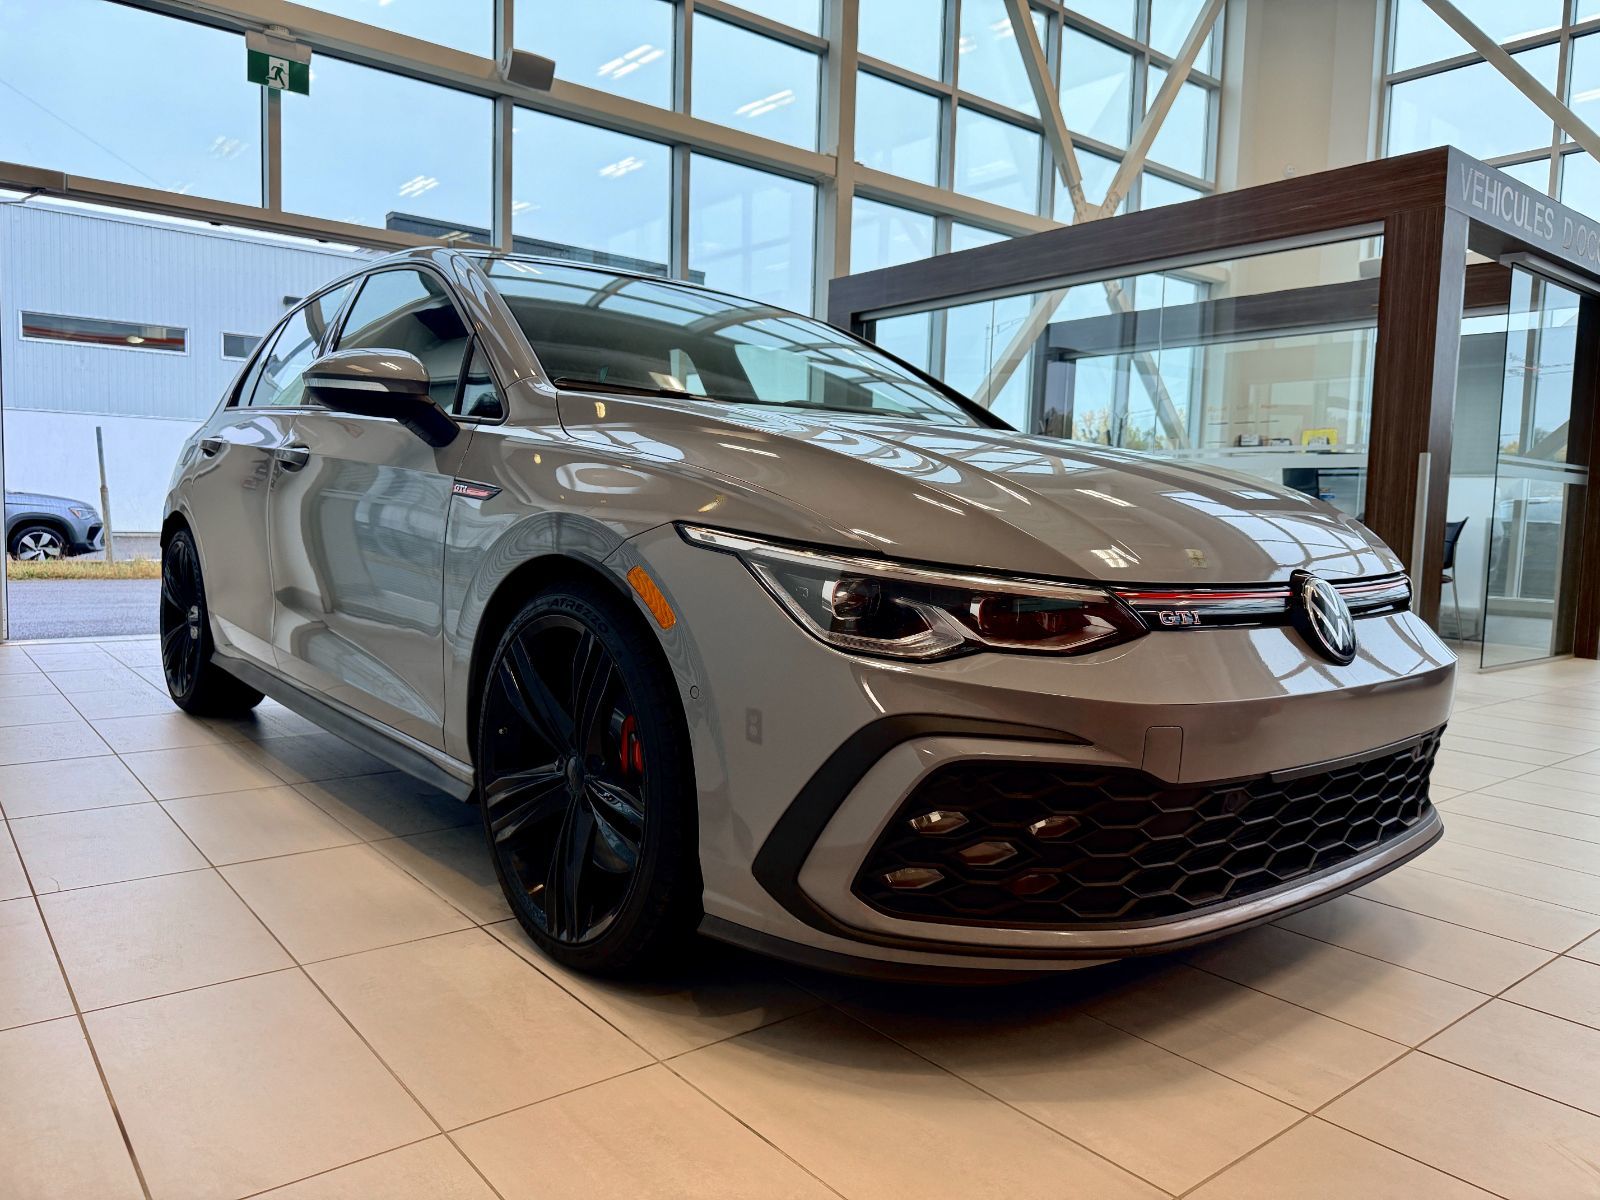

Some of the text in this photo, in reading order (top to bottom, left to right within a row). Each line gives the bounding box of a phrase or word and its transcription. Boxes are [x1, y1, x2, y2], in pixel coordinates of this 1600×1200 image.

[1460, 163, 1554, 240] VEHICULES
[549, 597, 609, 633] ATREZZO
[1159, 610, 1201, 625] GTI
